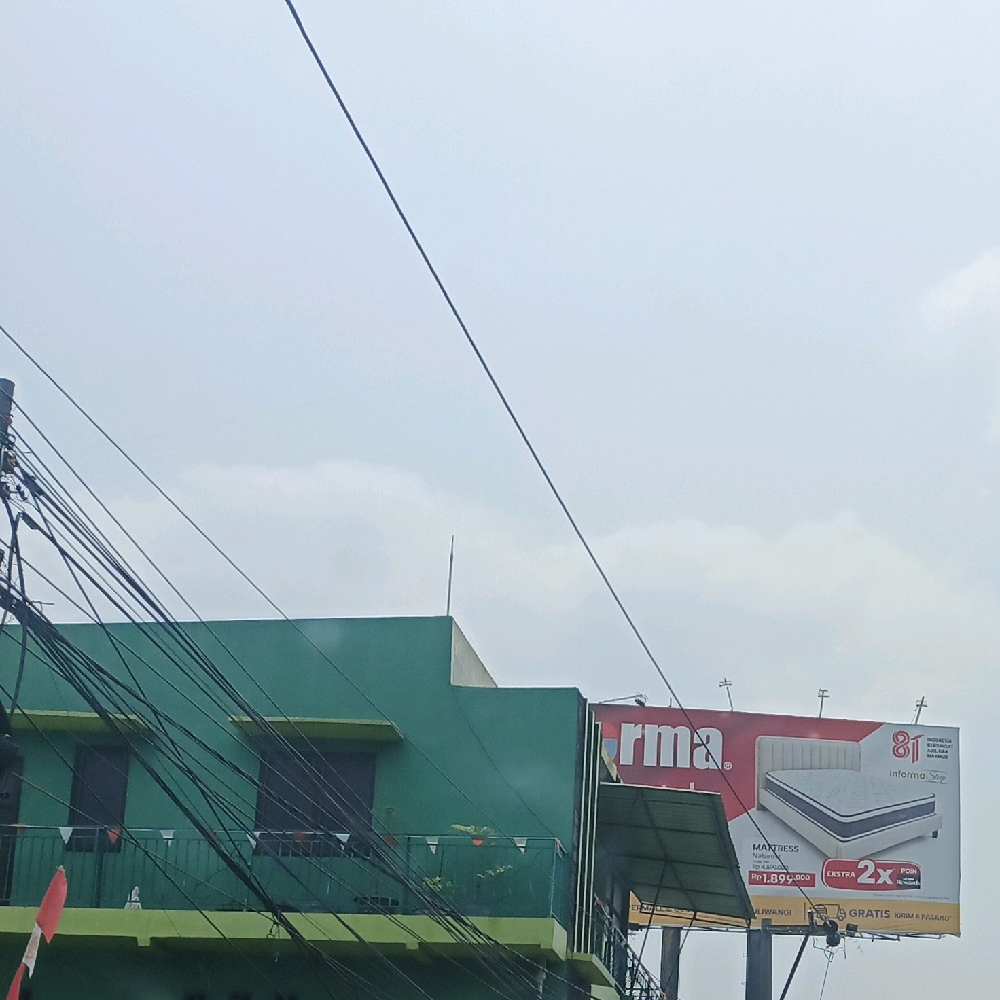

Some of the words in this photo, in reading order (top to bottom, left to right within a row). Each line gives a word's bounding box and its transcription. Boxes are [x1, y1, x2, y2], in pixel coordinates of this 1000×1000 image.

[889, 770, 926, 780] informa
[752, 843, 799, 853] MATTRESS
[826, 870, 856, 878] EKSTRA
[849, 909, 891, 919] GRATIS
